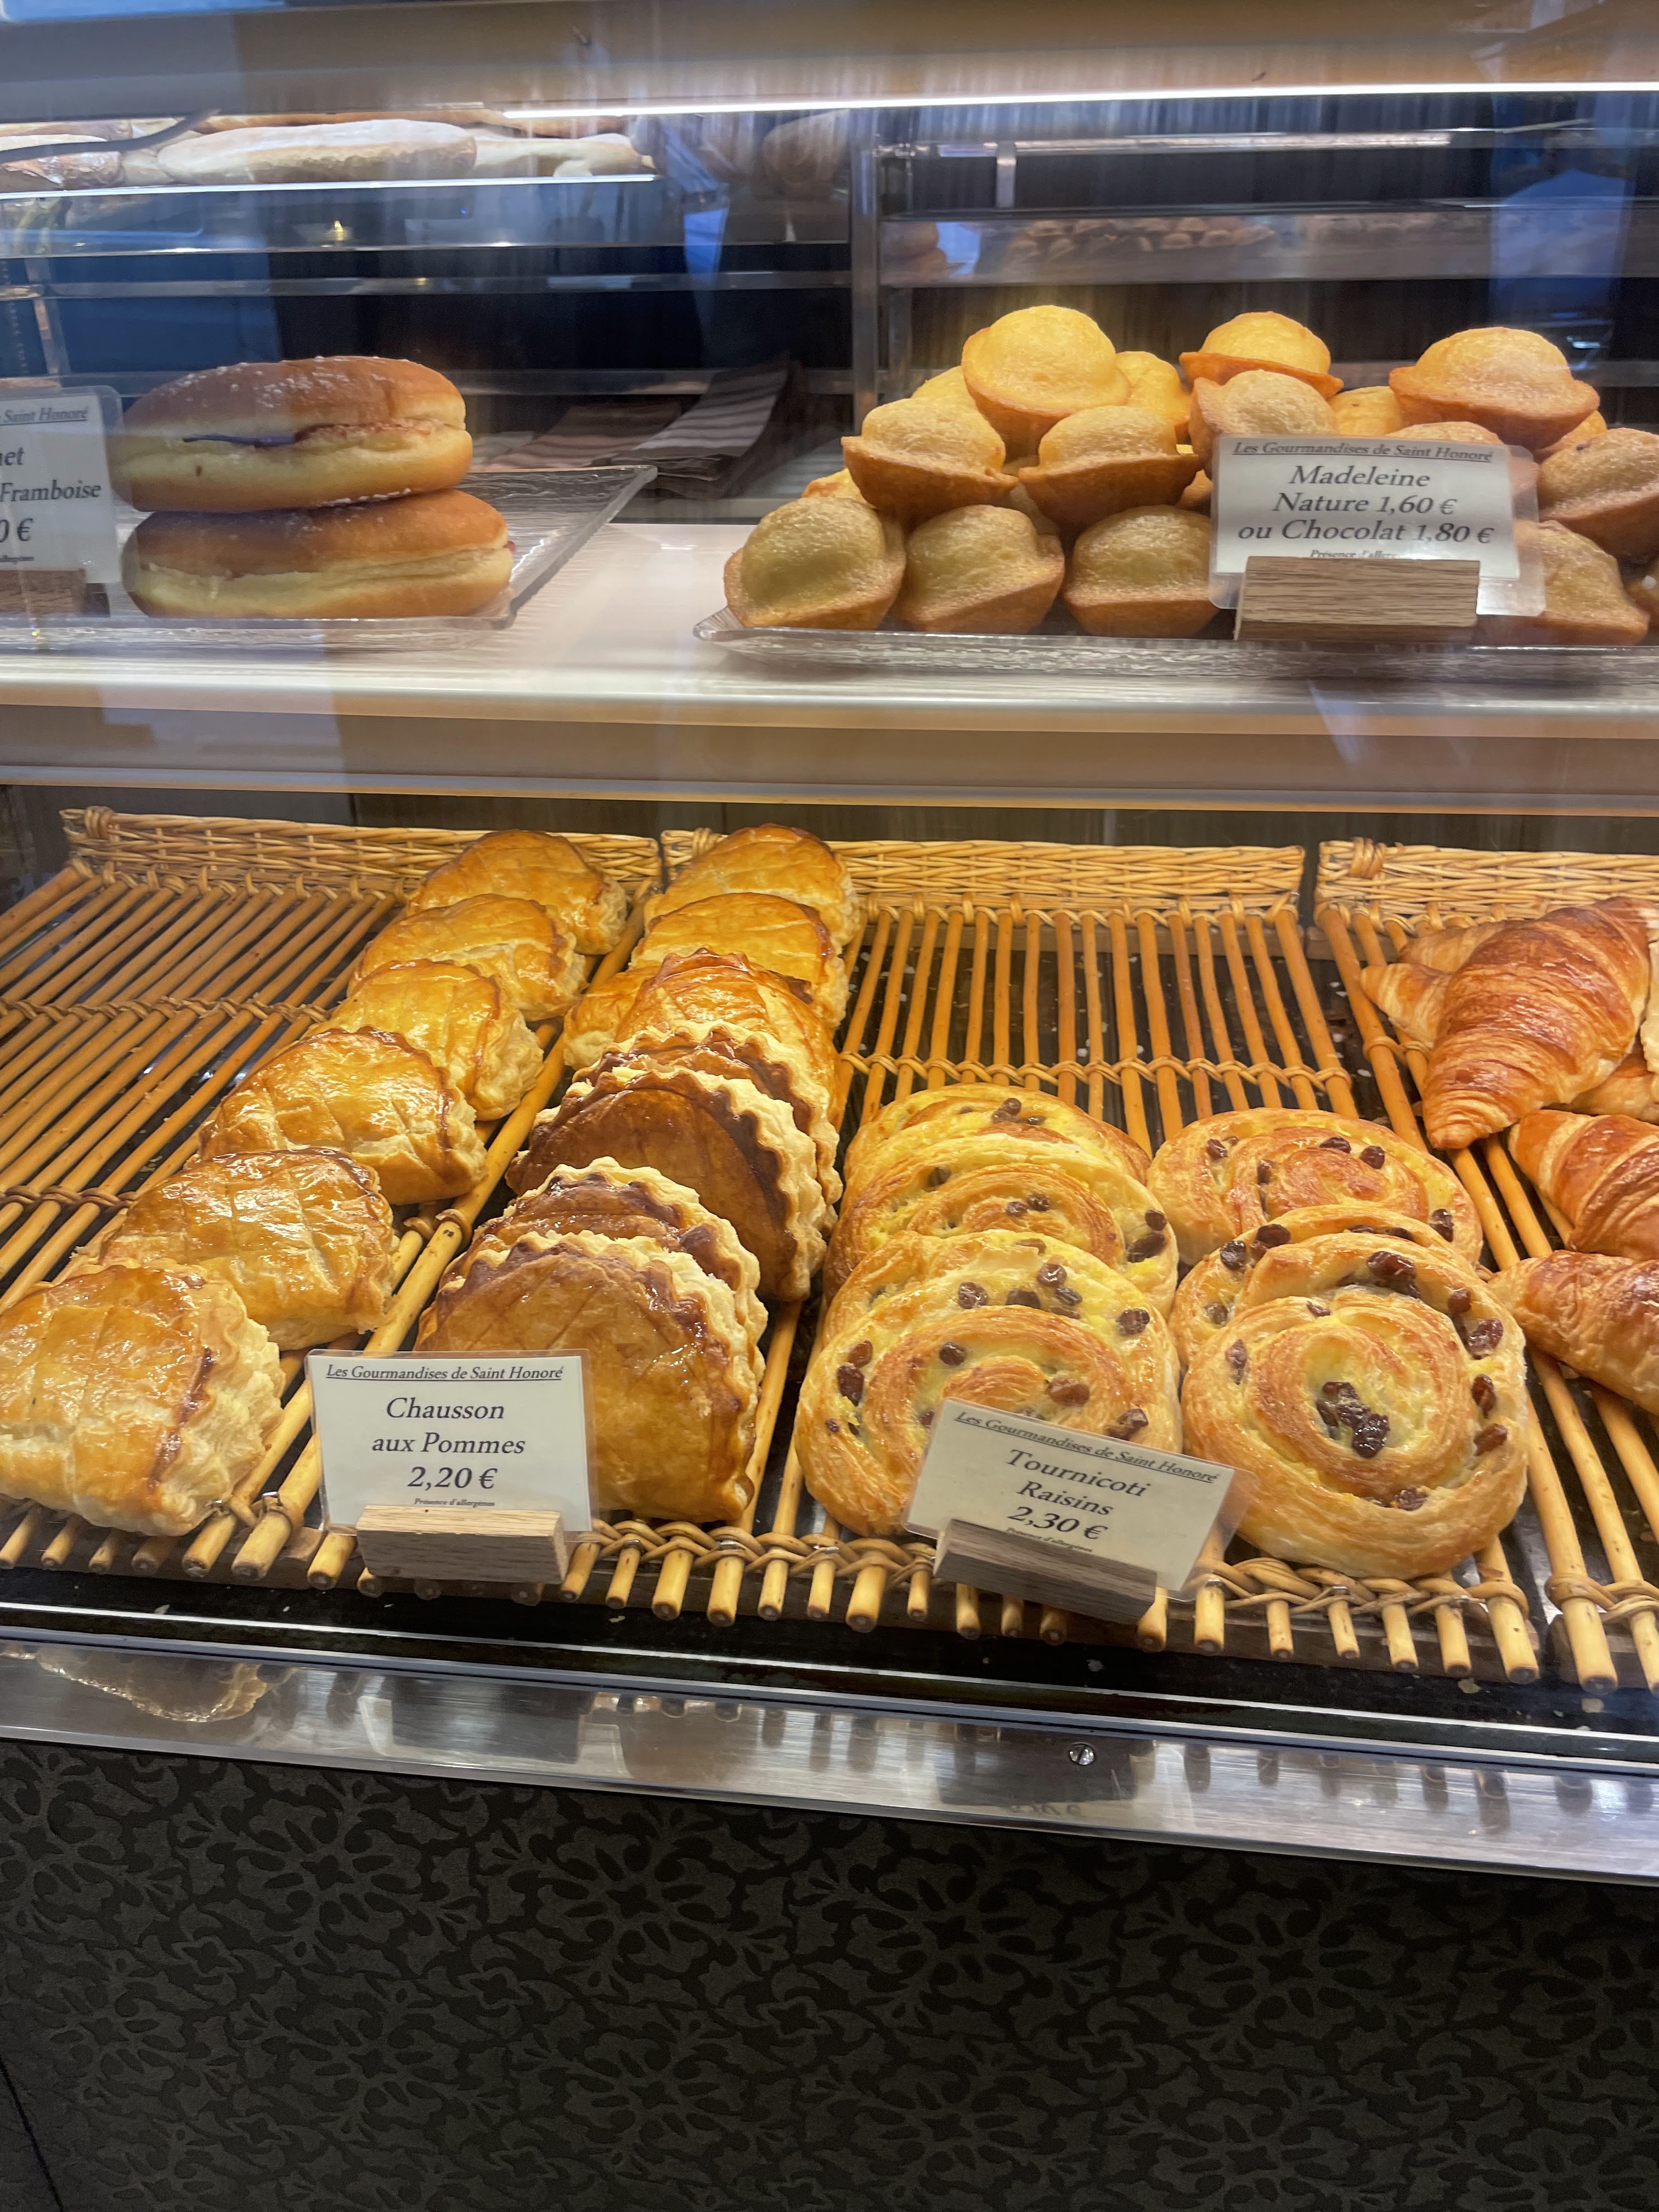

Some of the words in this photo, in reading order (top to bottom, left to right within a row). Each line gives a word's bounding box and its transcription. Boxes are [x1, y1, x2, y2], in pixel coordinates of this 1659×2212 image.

[0, 447, 26, 466] et
[1234, 442, 1258, 453] Les
[1263, 442, 1369, 454] Gourmandises
[1373, 444, 1391, 454] de
[1394, 445, 1431, 457] Saint
[1435, 447, 1494, 461] Honoré
[1288, 465, 1431, 487] Madeleine
[0, 479, 101, 502] Framboise
[1272, 493, 1369, 512] Nature
[1375, 495, 1434, 515] 1,60
[1438, 498, 1458, 515] €
[17, 518, 33, 541] €
[1238, 527, 1271, 540] ou
[1281, 520, 1406, 541] Chocolat
[1415, 523, 1471, 543] 1,80
[1476, 527, 1495, 544] €
[325, 1364, 348, 1378] Les
[351, 1366, 448, 1379] Gourmandises
[451, 1367, 467, 1379] de
[470, 1367, 505, 1379] Saint
[509, 1365, 563, 1379] Honoré
[386, 1397, 505, 1419] Chausson
[371, 1437, 415, 1453] aux
[420, 1432, 526, 1454] Pommes
[957, 1412, 983, 1424] Les
[985, 1419, 1093, 1453] Gourmandises
[1094, 1447, 1114, 1457] de
[1115, 1451, 1156, 1468] Saint
[1157, 1461, 1220, 1482] Honoré
[407, 1466, 472, 1491] 2,20
[478, 1467, 498, 1489] €
[1006, 1449, 1151, 1497] Tournicoti
[1016, 1481, 1114, 1516] Raisins
[1007, 1506, 1080, 1532] 2,30
[1084, 1525, 1108, 1539] €
